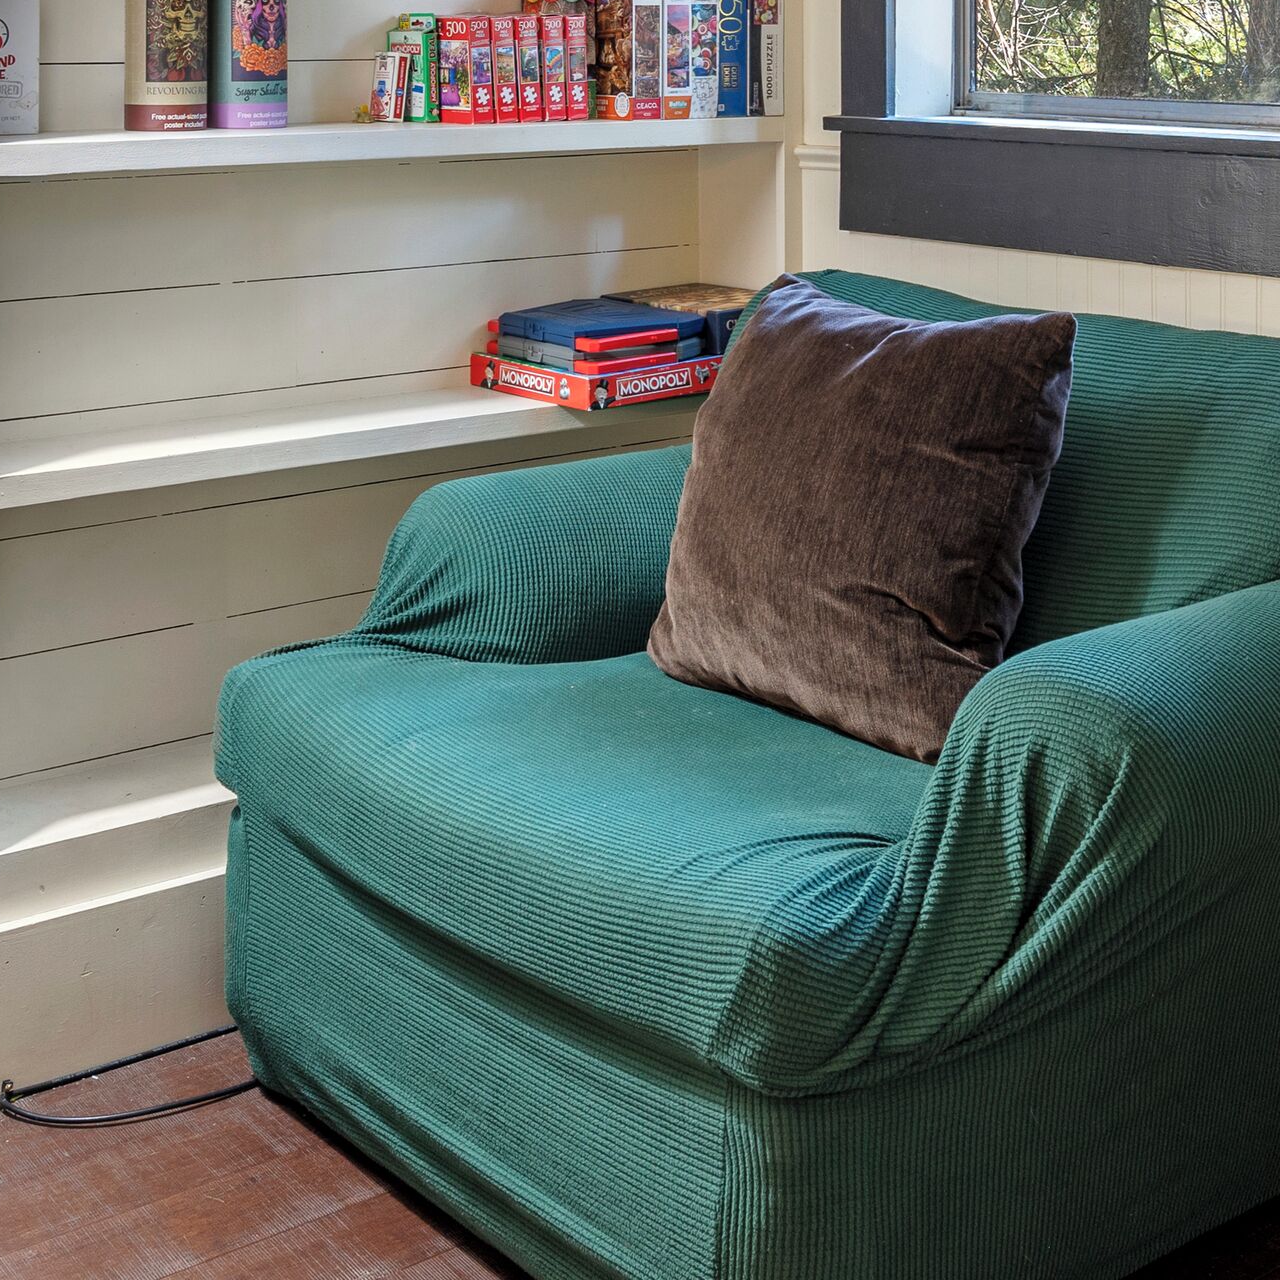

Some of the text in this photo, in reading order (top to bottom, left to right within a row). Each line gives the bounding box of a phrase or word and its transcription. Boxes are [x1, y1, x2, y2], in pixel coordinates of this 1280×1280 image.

[446, 20, 466, 37] 500
[470, 21, 488, 32] 500
[494, 21, 512, 31] 500
[518, 20, 536, 31] 500
[545, 20, 562, 30] 500
[568, 20, 585, 31] 500
[428, 37, 436, 58] DEAL
[146, 86, 197, 96] REVOLVING
[235, 84, 279, 101] Sugar Skull
[501, 368, 553, 392] MONOPOLY
[620, 371, 688, 396] MONOPOLY
